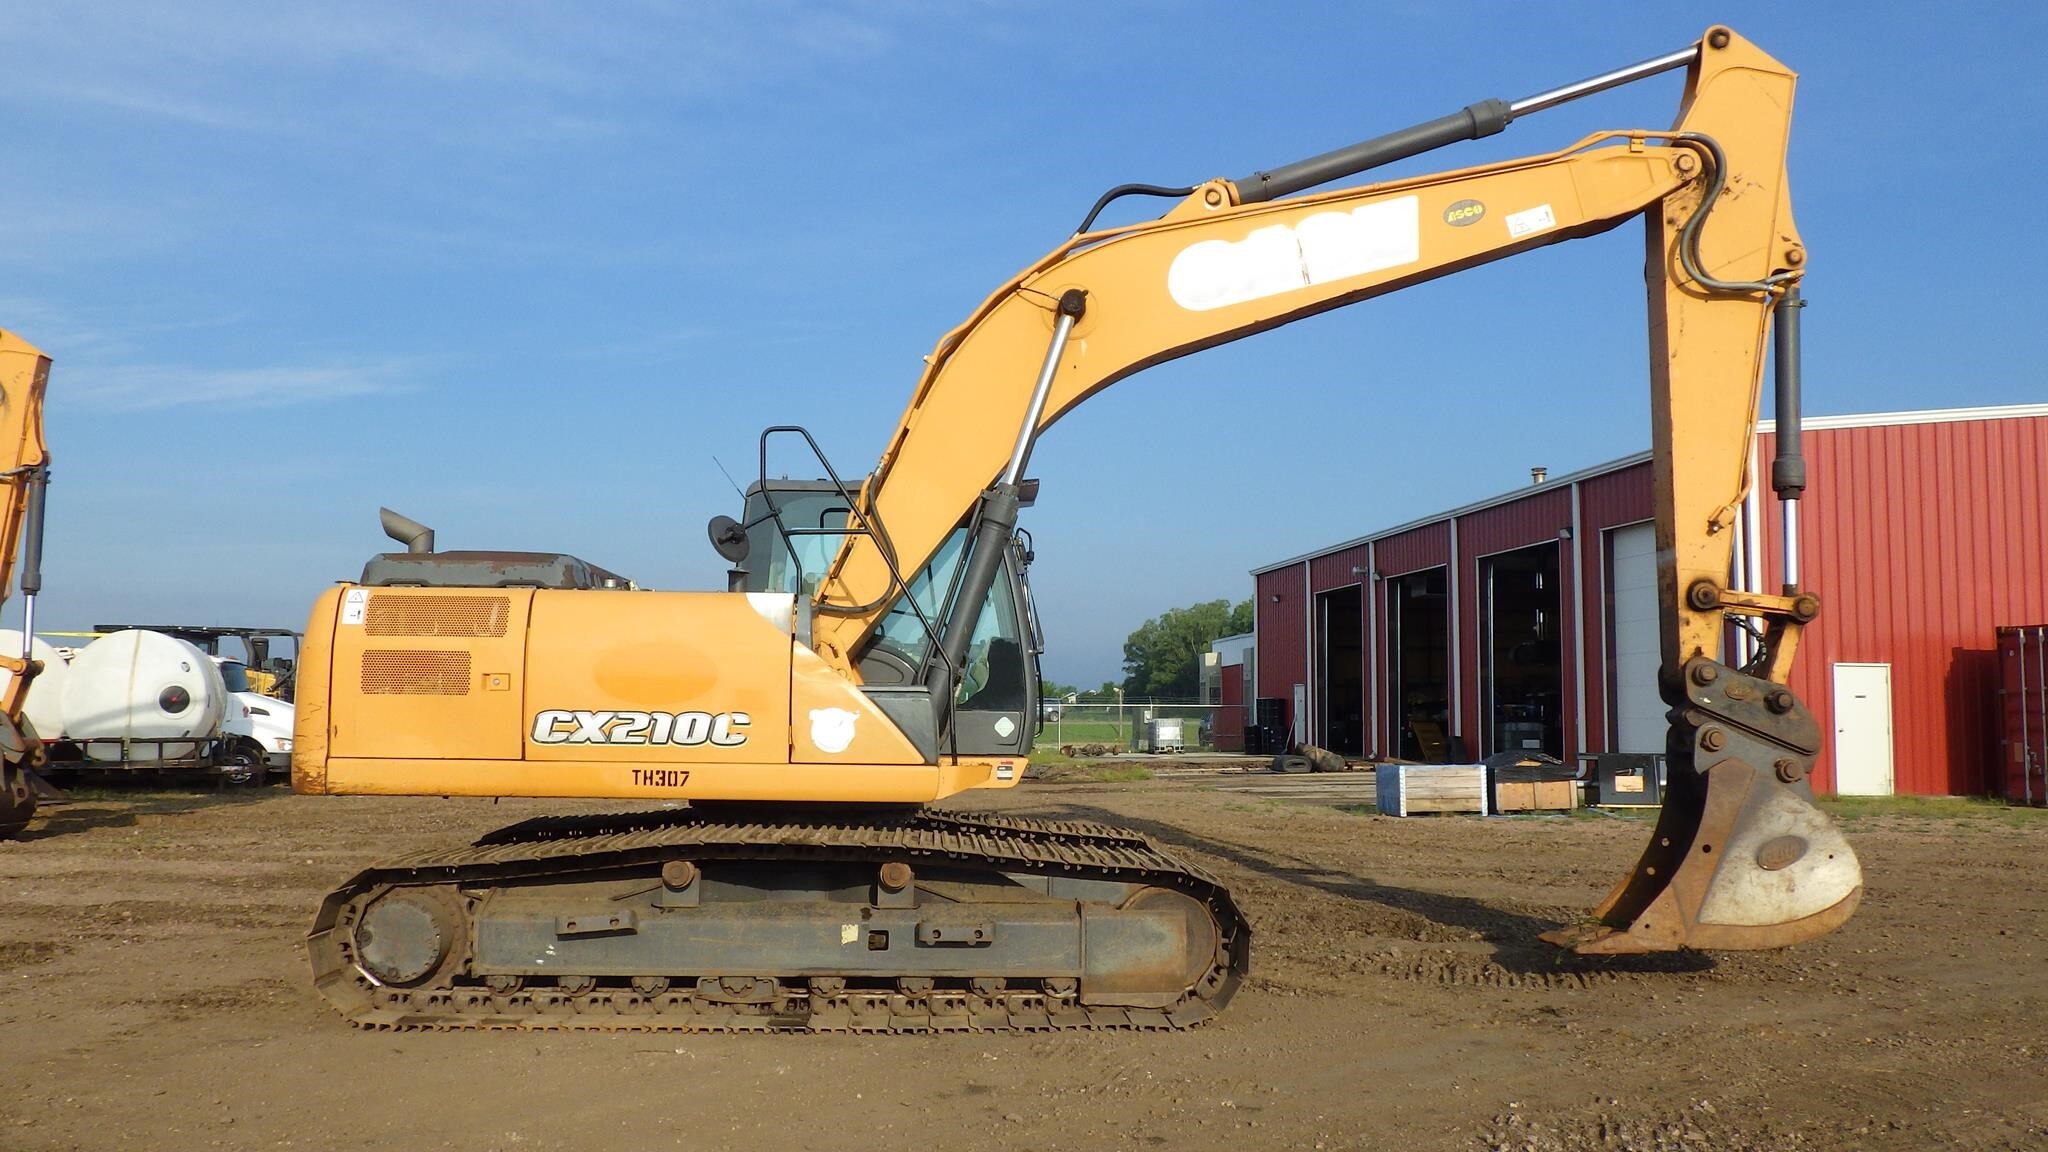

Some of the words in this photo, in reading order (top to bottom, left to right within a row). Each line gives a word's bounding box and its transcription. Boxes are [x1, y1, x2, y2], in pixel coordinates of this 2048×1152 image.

[1447, 204, 1483, 223] ASCO
[532, 709, 751, 746] CX210C
[631, 769, 690, 787] TH307
